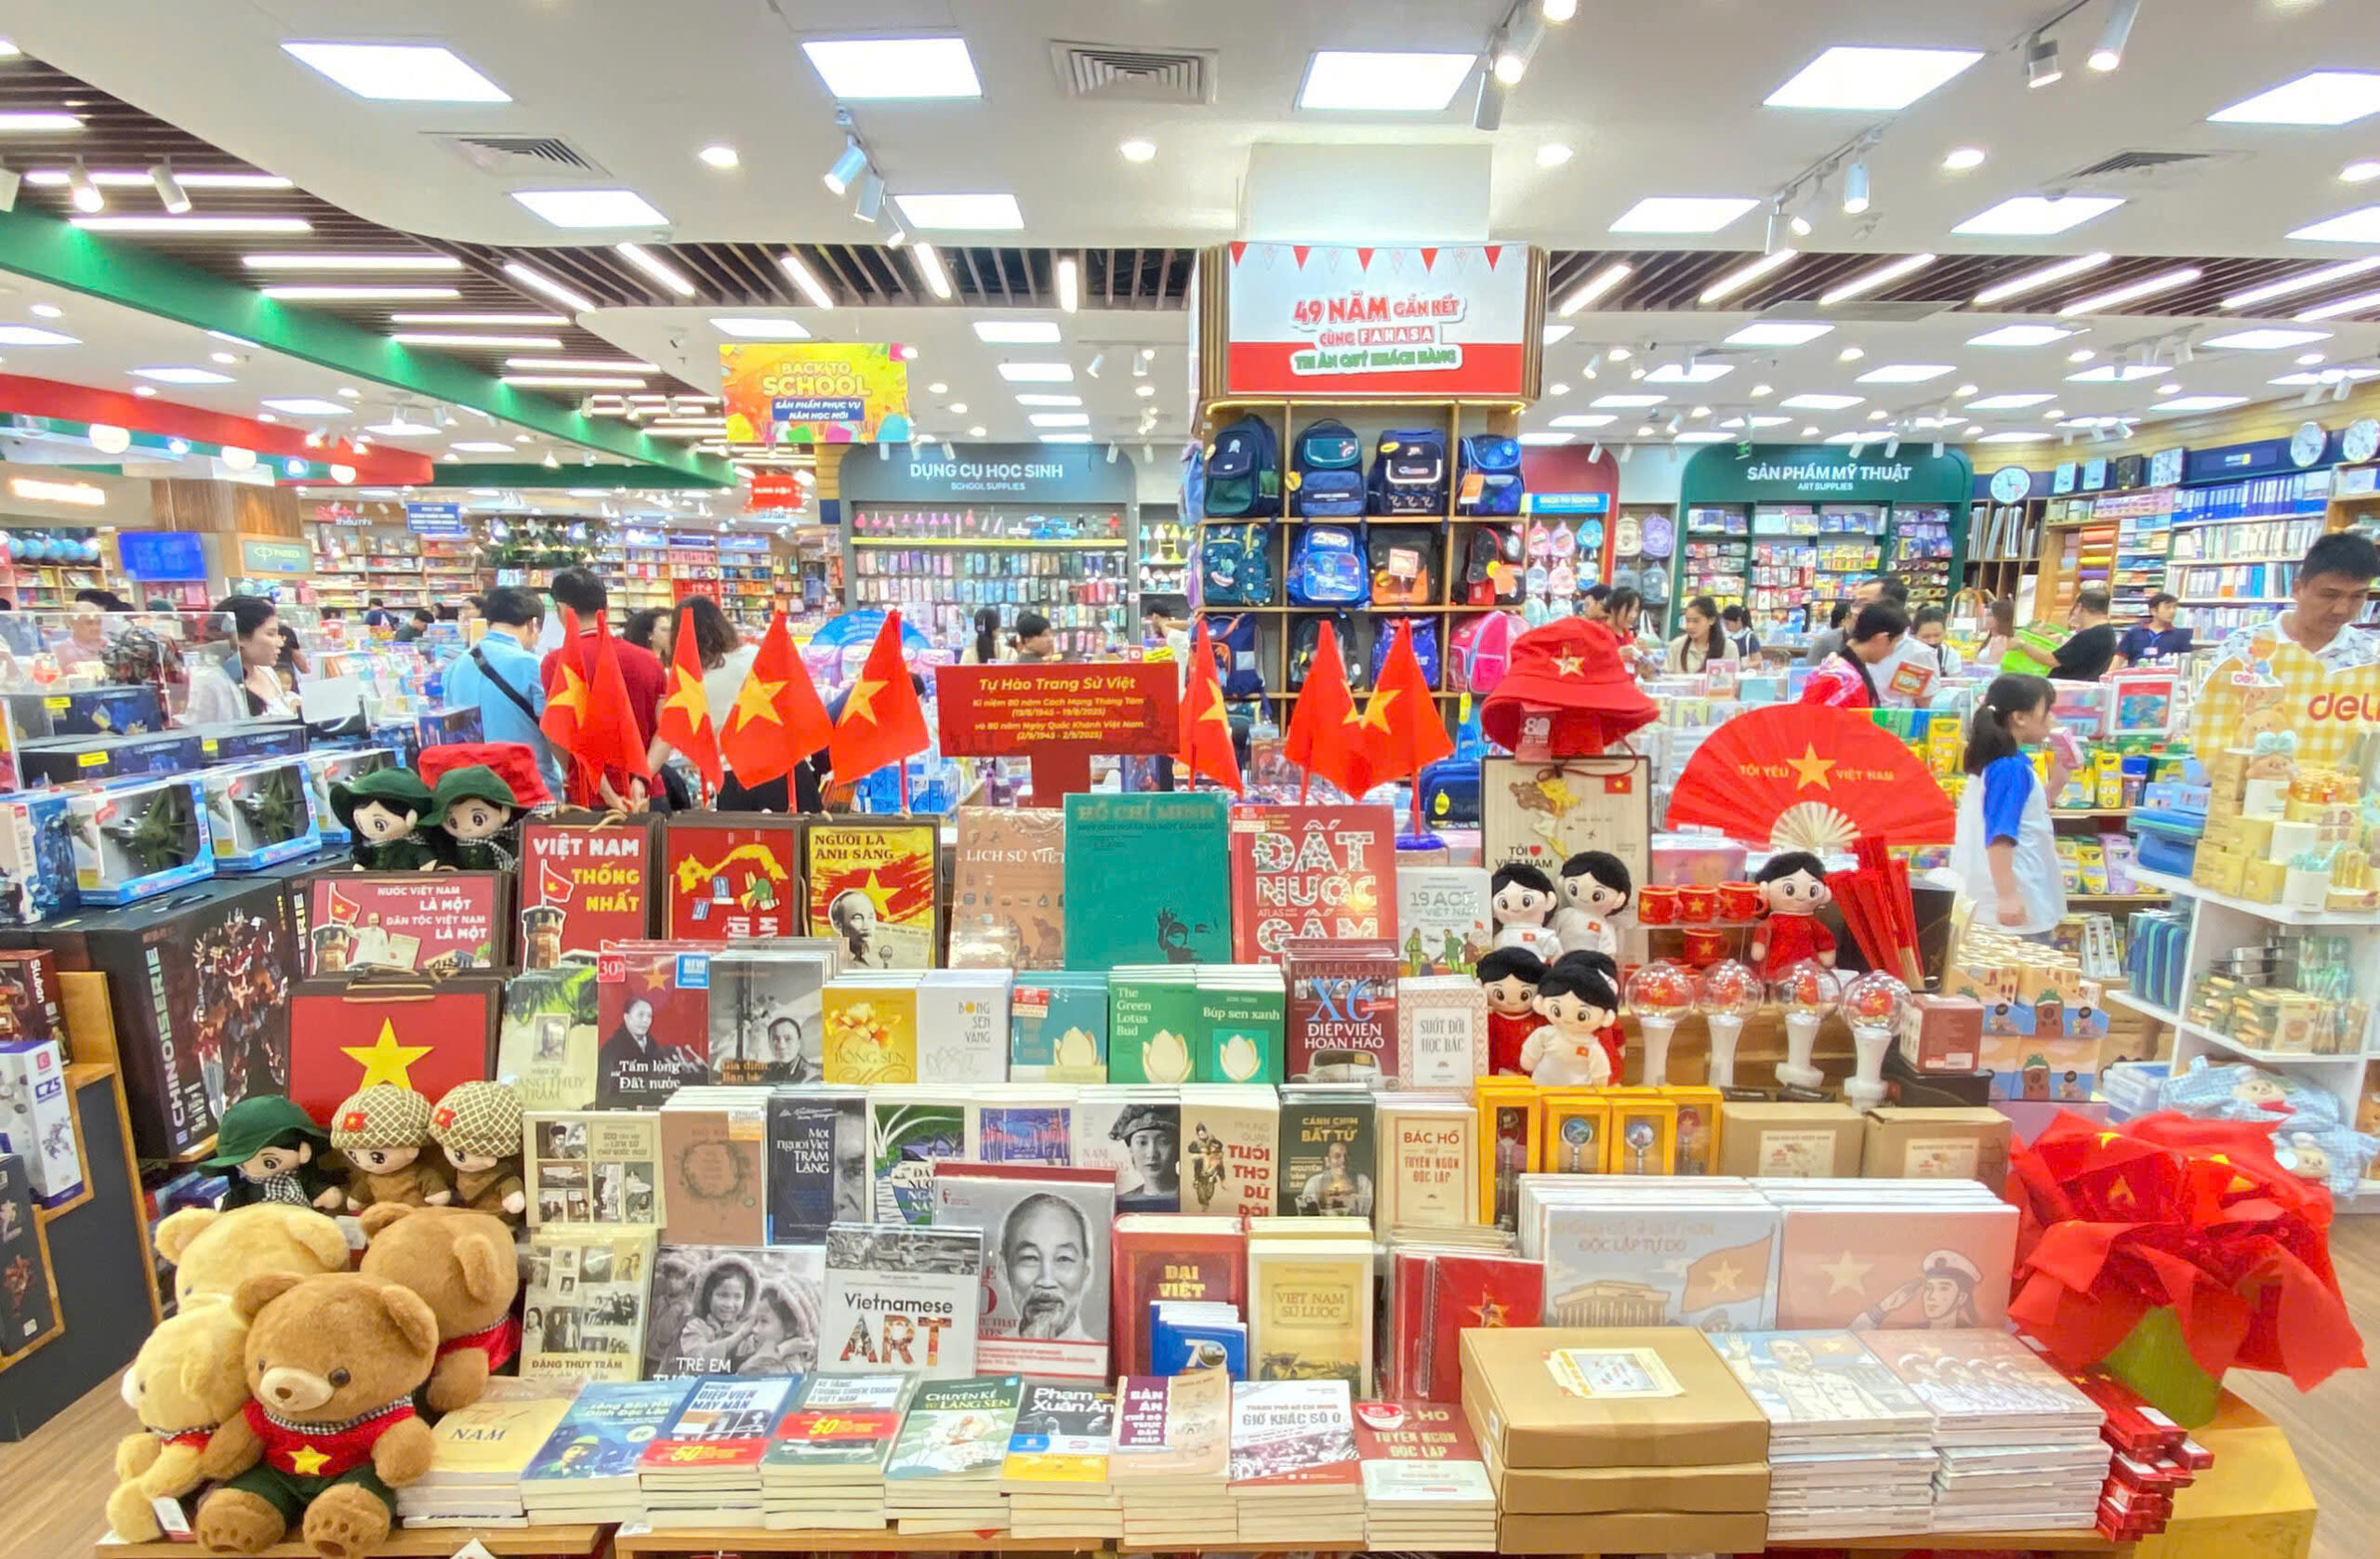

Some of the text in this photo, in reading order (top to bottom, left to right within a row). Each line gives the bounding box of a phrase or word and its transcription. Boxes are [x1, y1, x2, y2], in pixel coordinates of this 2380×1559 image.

[1293, 297, 1324, 324] 49
[1328, 291, 1390, 324] NĂM
[762, 376, 871, 397] SCHOOL
[986, 463, 1021, 482] HỌC
[1025, 464, 1063, 478] SINH
[979, 679, 998, 692] Tự
[1001, 678, 1032, 691] Hào
[1036, 679, 1079, 693] Trang
[532, 832, 640, 861] VIỆT NAM
[571, 862, 640, 885] THỐNG
[585, 891, 640, 912] NHẤT
[1117, 987, 1139, 998] The
[1116, 1000, 1152, 1011] Green
[1202, 1006, 1280, 1021] Búp sen xanh
[1116, 1012, 1148, 1024] Lotus
[1116, 1025, 1139, 1037] Bud
[1403, 1130, 1432, 1143] BÁC
[844, 1292, 953, 1314] Vietnamese
[840, 1314, 952, 1367] ART
[708, 1357, 732, 1373] EM
[449, 1428, 507, 1442] NAM
